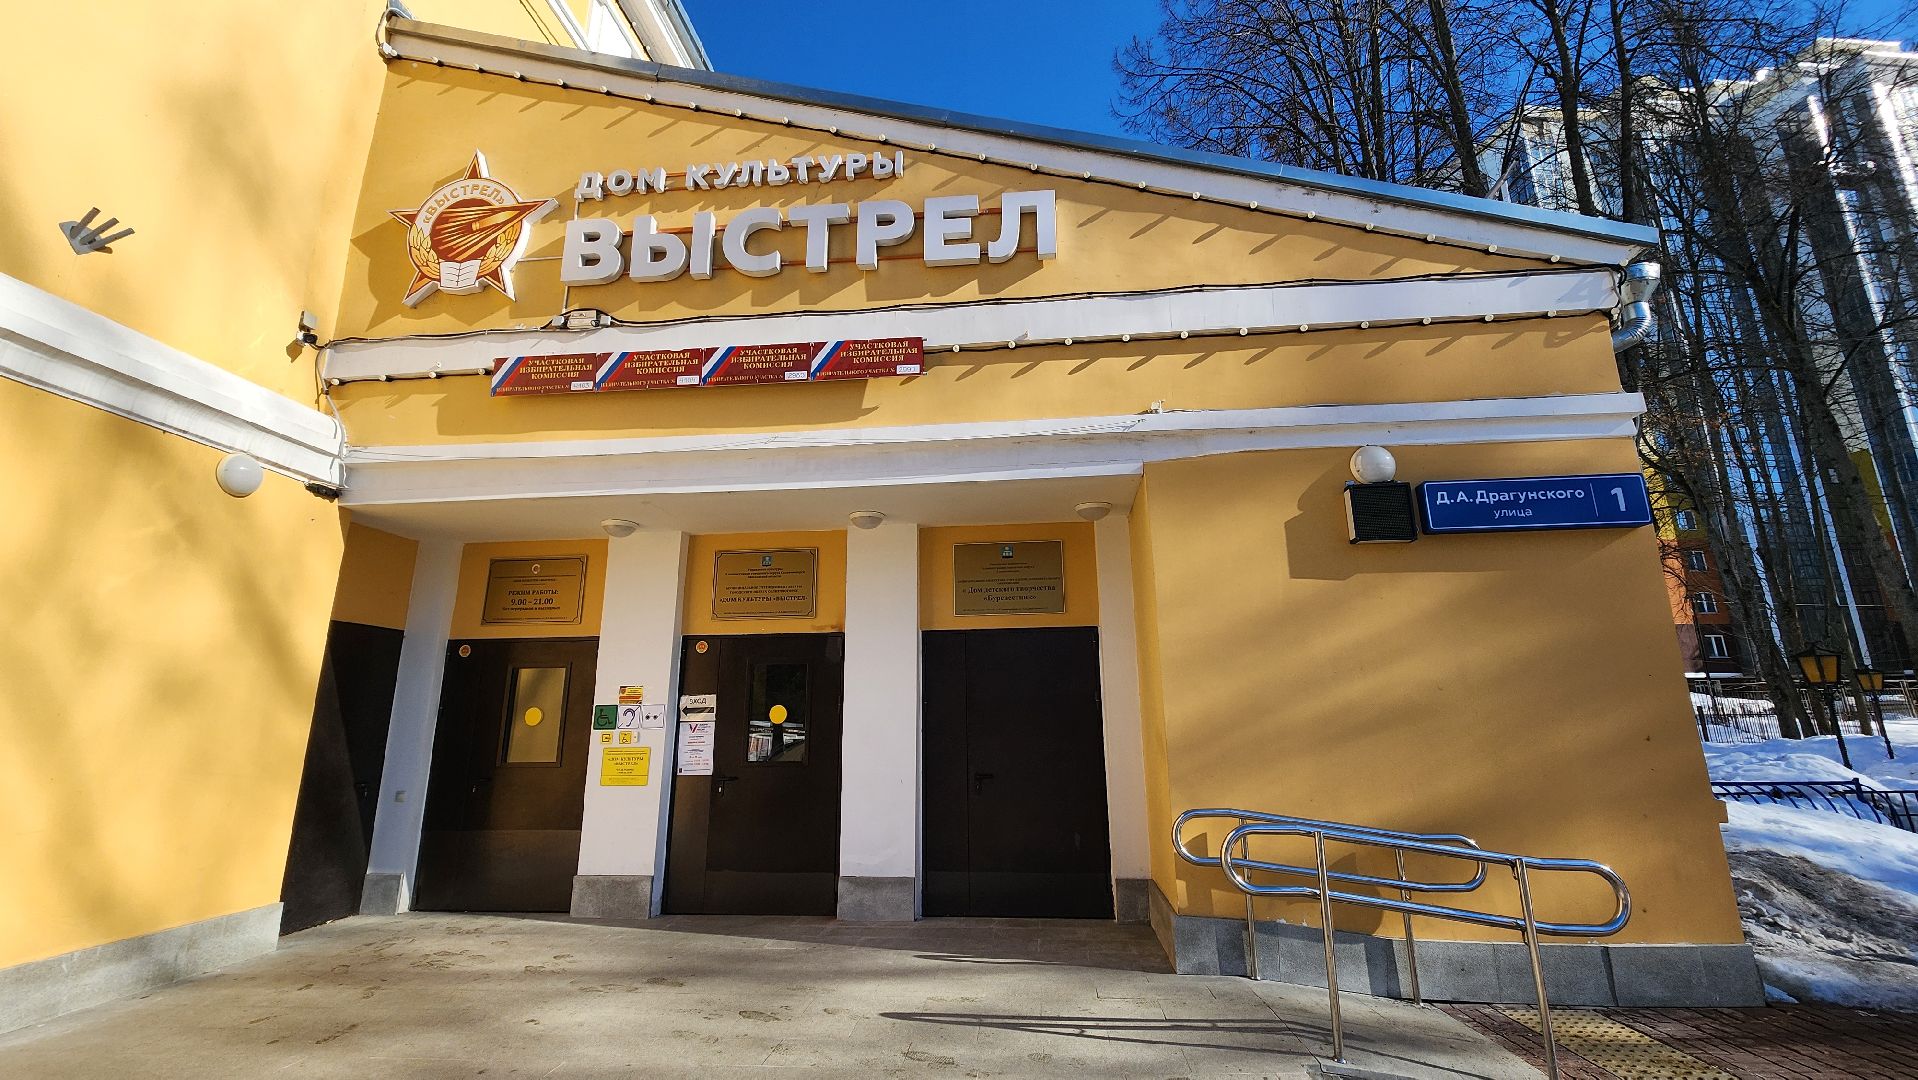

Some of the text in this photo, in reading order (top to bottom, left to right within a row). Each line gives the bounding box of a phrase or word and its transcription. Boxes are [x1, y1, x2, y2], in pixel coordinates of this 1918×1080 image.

[574, 151, 904, 201] ДОМ КУЛЬТУРЫ
[561, 190, 1057, 286] ВЫСТРЕЛ
[849, 341, 909, 350] УЧАСТКОВАЯ
[740, 347, 798, 356] УЧАСТКОВАЯ
[840, 348, 918, 357] ИЗБИРАТЕЛЬНАЯ
[633, 352, 690, 361] УЧАСТКОВАЯ
[731, 354, 807, 364] ИЗБИРАТЕЛЬНАЯ
[853, 355, 904, 364] КОМИССИЯ
[528, 358, 584, 366] УЧАСТКОВАЯ
[624, 359, 699, 369] ИЗБИРАТЕЛЬНАЯ
[743, 361, 793, 370] КОМИССИЯ
[519, 364, 593, 374] ИЗБИРАТЕЛЬНАЯ
[636, 366, 685, 375] КОМИССИЯ
[531, 371, 579, 380] КОМИССИЯ
[1610, 487, 1627, 512] 1
[1493, 507, 1534, 519] улица
[511, 598, 527, 606] 9.00
[533, 597, 554, 605] 21.00
